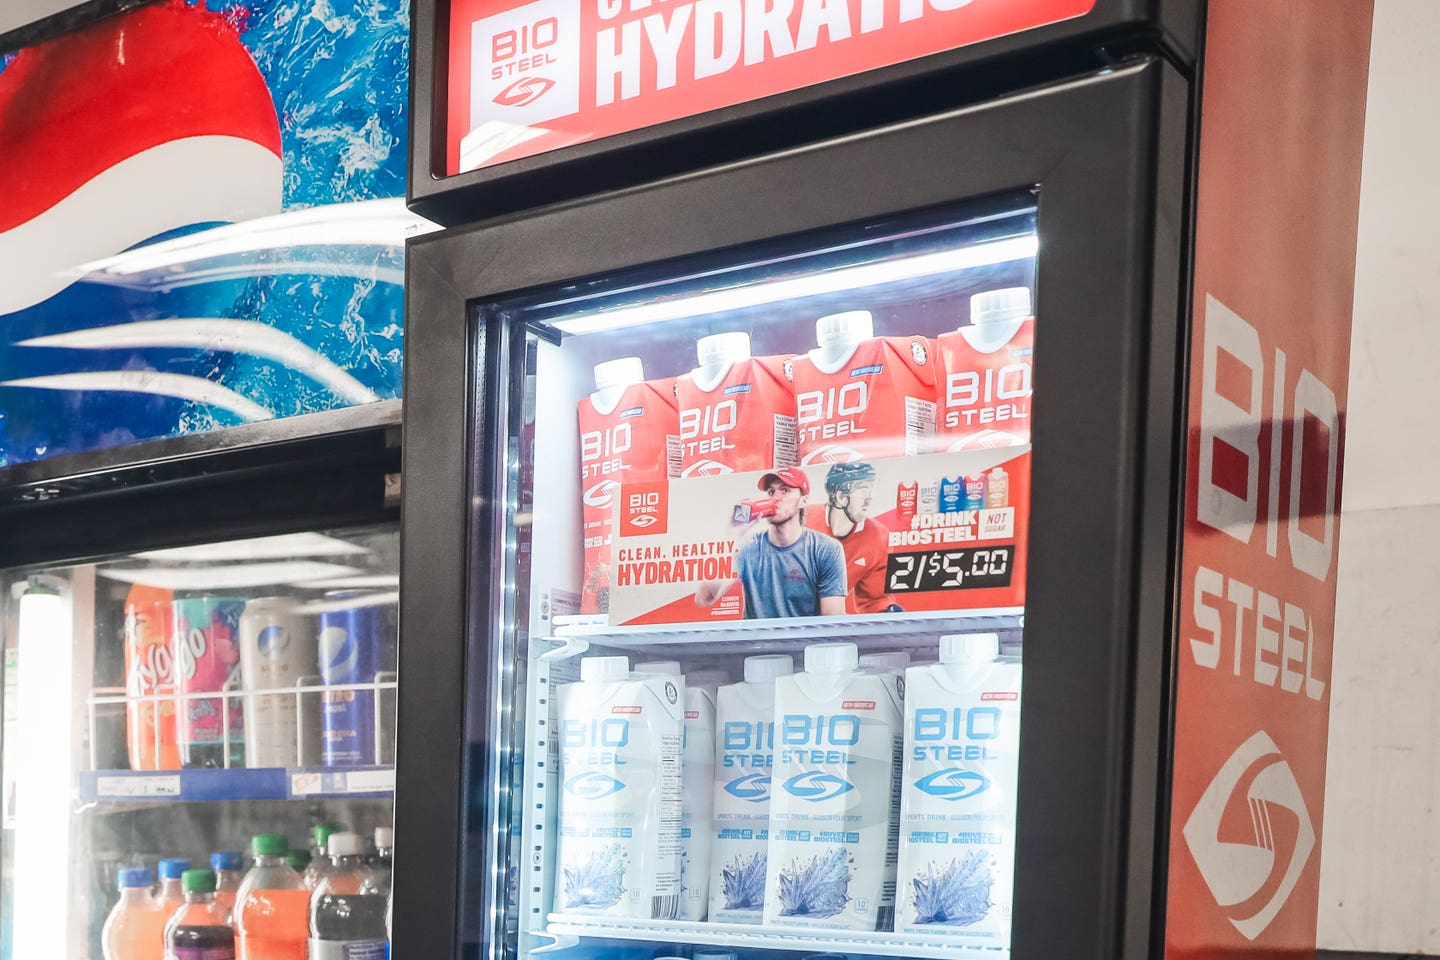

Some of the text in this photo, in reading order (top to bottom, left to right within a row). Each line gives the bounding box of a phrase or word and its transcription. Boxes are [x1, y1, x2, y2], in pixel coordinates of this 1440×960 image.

[492, 17, 558, 62] BIO
[491, 53, 557, 80] STEEL
[596, 0, 975, 107] HYDRA
[946, 363, 1032, 408] BIO
[797, 381, 868, 425] BIO
[945, 404, 1030, 428] STEEL
[680, 399, 737, 439] BIO
[798, 420, 867, 444] STEEL
[581, 422, 632, 461] BIO
[681, 435, 736, 457] STEEL
[1197, 293, 1339, 582] BIO
[582, 458, 632, 479] STEEL
[630, 493, 658, 506] BIO
[911, 510, 978, 529] #DRINK
[984, 525, 1006, 533] SUGAR
[987, 513, 1007, 524] NOT
[888, 526, 977, 547] BIOSTEEL
[619, 541, 739, 561] CLEAN. HEALTHY.
[618, 556, 737, 586] HYDRATION.
[890, 549, 1008, 589] 2/$5.00
[1190, 564, 1326, 701] STEEL
[562, 718, 629, 748] BIO
[725, 721, 773, 749] BI
[782, 715, 860, 746] BIO
[914, 707, 1002, 742] BIO
[724, 754, 773, 768] STEE
[782, 751, 856, 765] STEEL
[913, 745, 994, 761] STEEL
